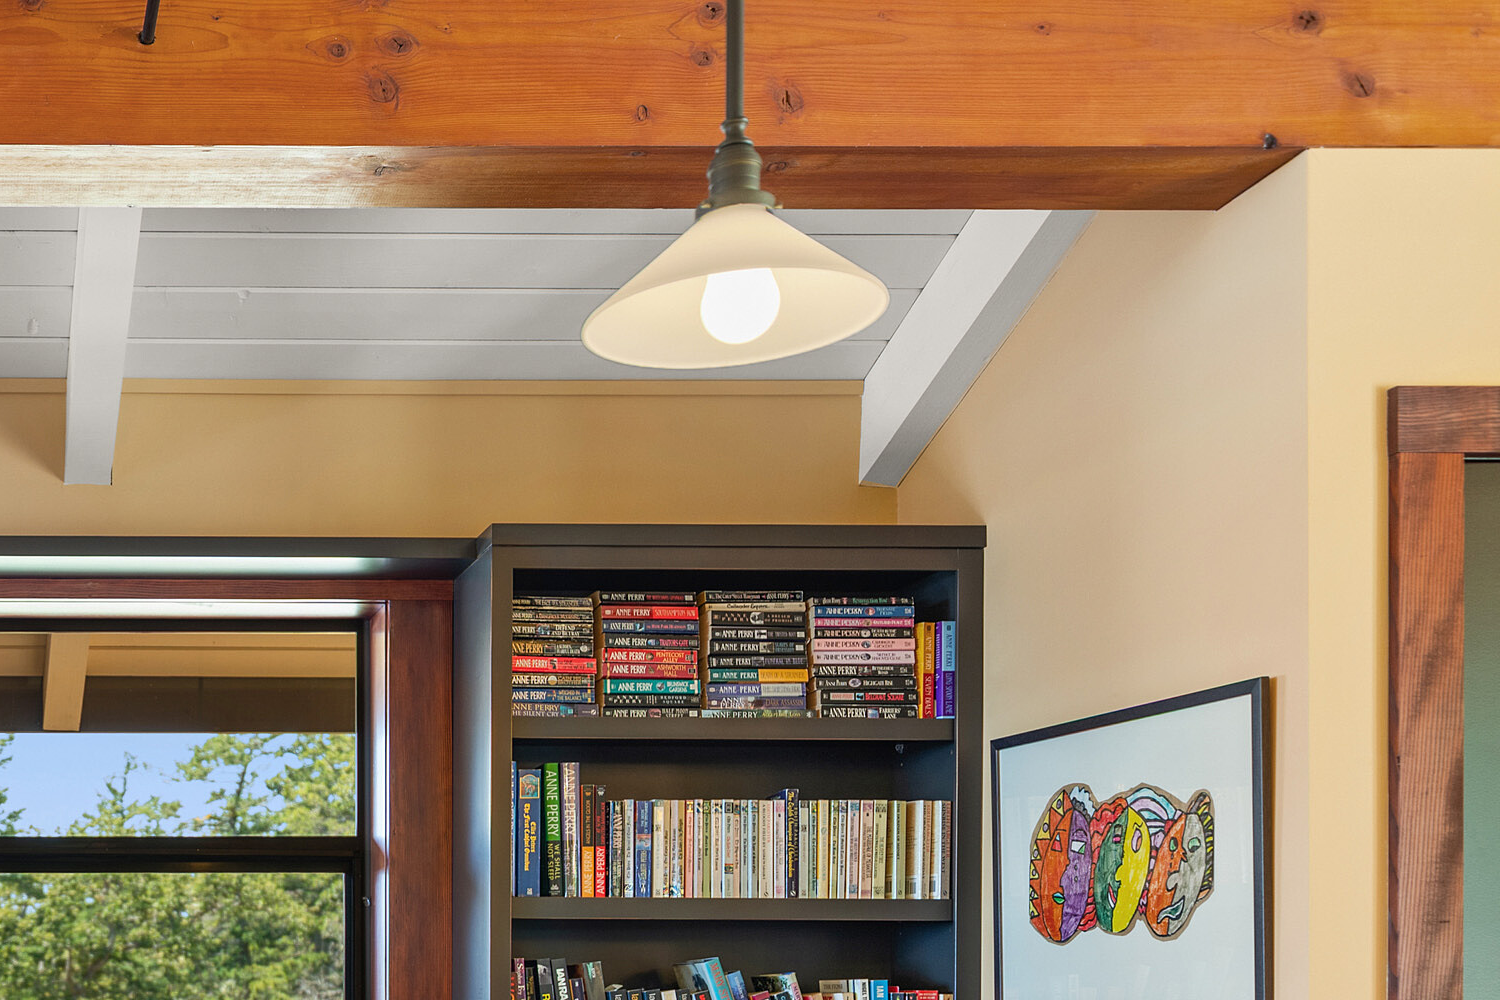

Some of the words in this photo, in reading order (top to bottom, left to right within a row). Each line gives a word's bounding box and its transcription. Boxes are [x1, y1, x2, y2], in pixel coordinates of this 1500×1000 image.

[610, 652, 628, 661] ANNE
[629, 652, 646, 661] PERRY
[719, 685, 738, 694] ANNE
[739, 685, 760, 694] PERRY
[546, 770, 557, 800] ANNE
[546, 804, 558, 836] PERRY
[554, 844, 560, 855] WE
[711, 963, 723, 986] MARY
